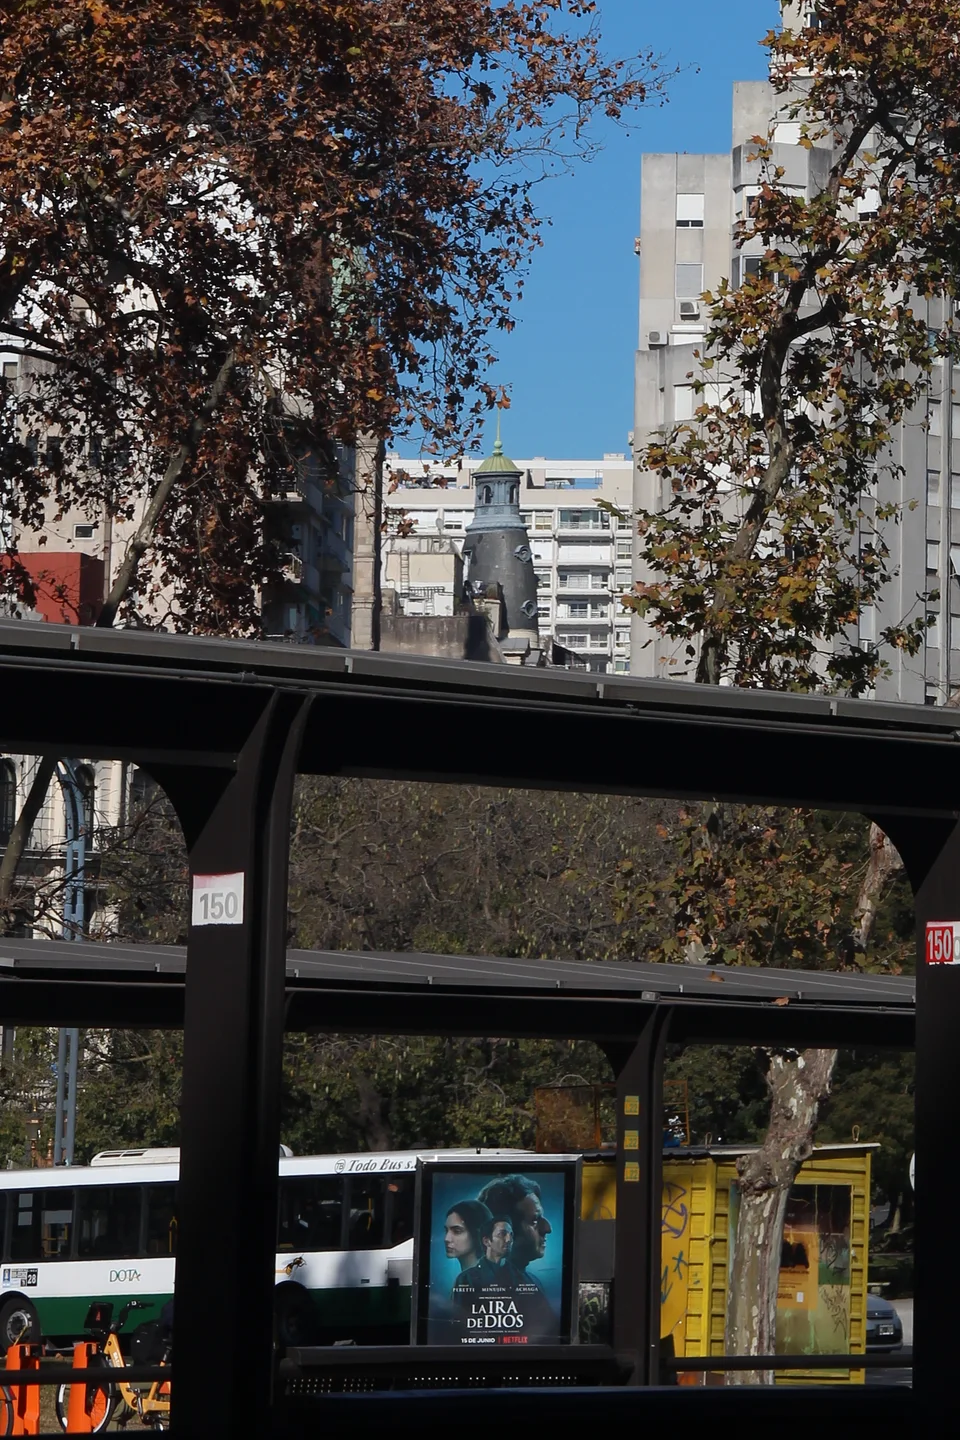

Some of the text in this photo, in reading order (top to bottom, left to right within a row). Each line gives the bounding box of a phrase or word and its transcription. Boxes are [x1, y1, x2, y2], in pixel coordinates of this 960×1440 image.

[199, 891, 239, 920] 150
[927, 928, 952, 961] 150
[348, 1159, 377, 1171] Todo
[380, 1158, 403, 1170] Bus
[27, 1273, 37, 1285] 28
[109, 1269, 141, 1283] DOTA
[471, 1300, 519, 1314] LA IRA
[466, 1314, 524, 1328] DE DIOS
[502, 1336, 528, 1344] NETFLIX
